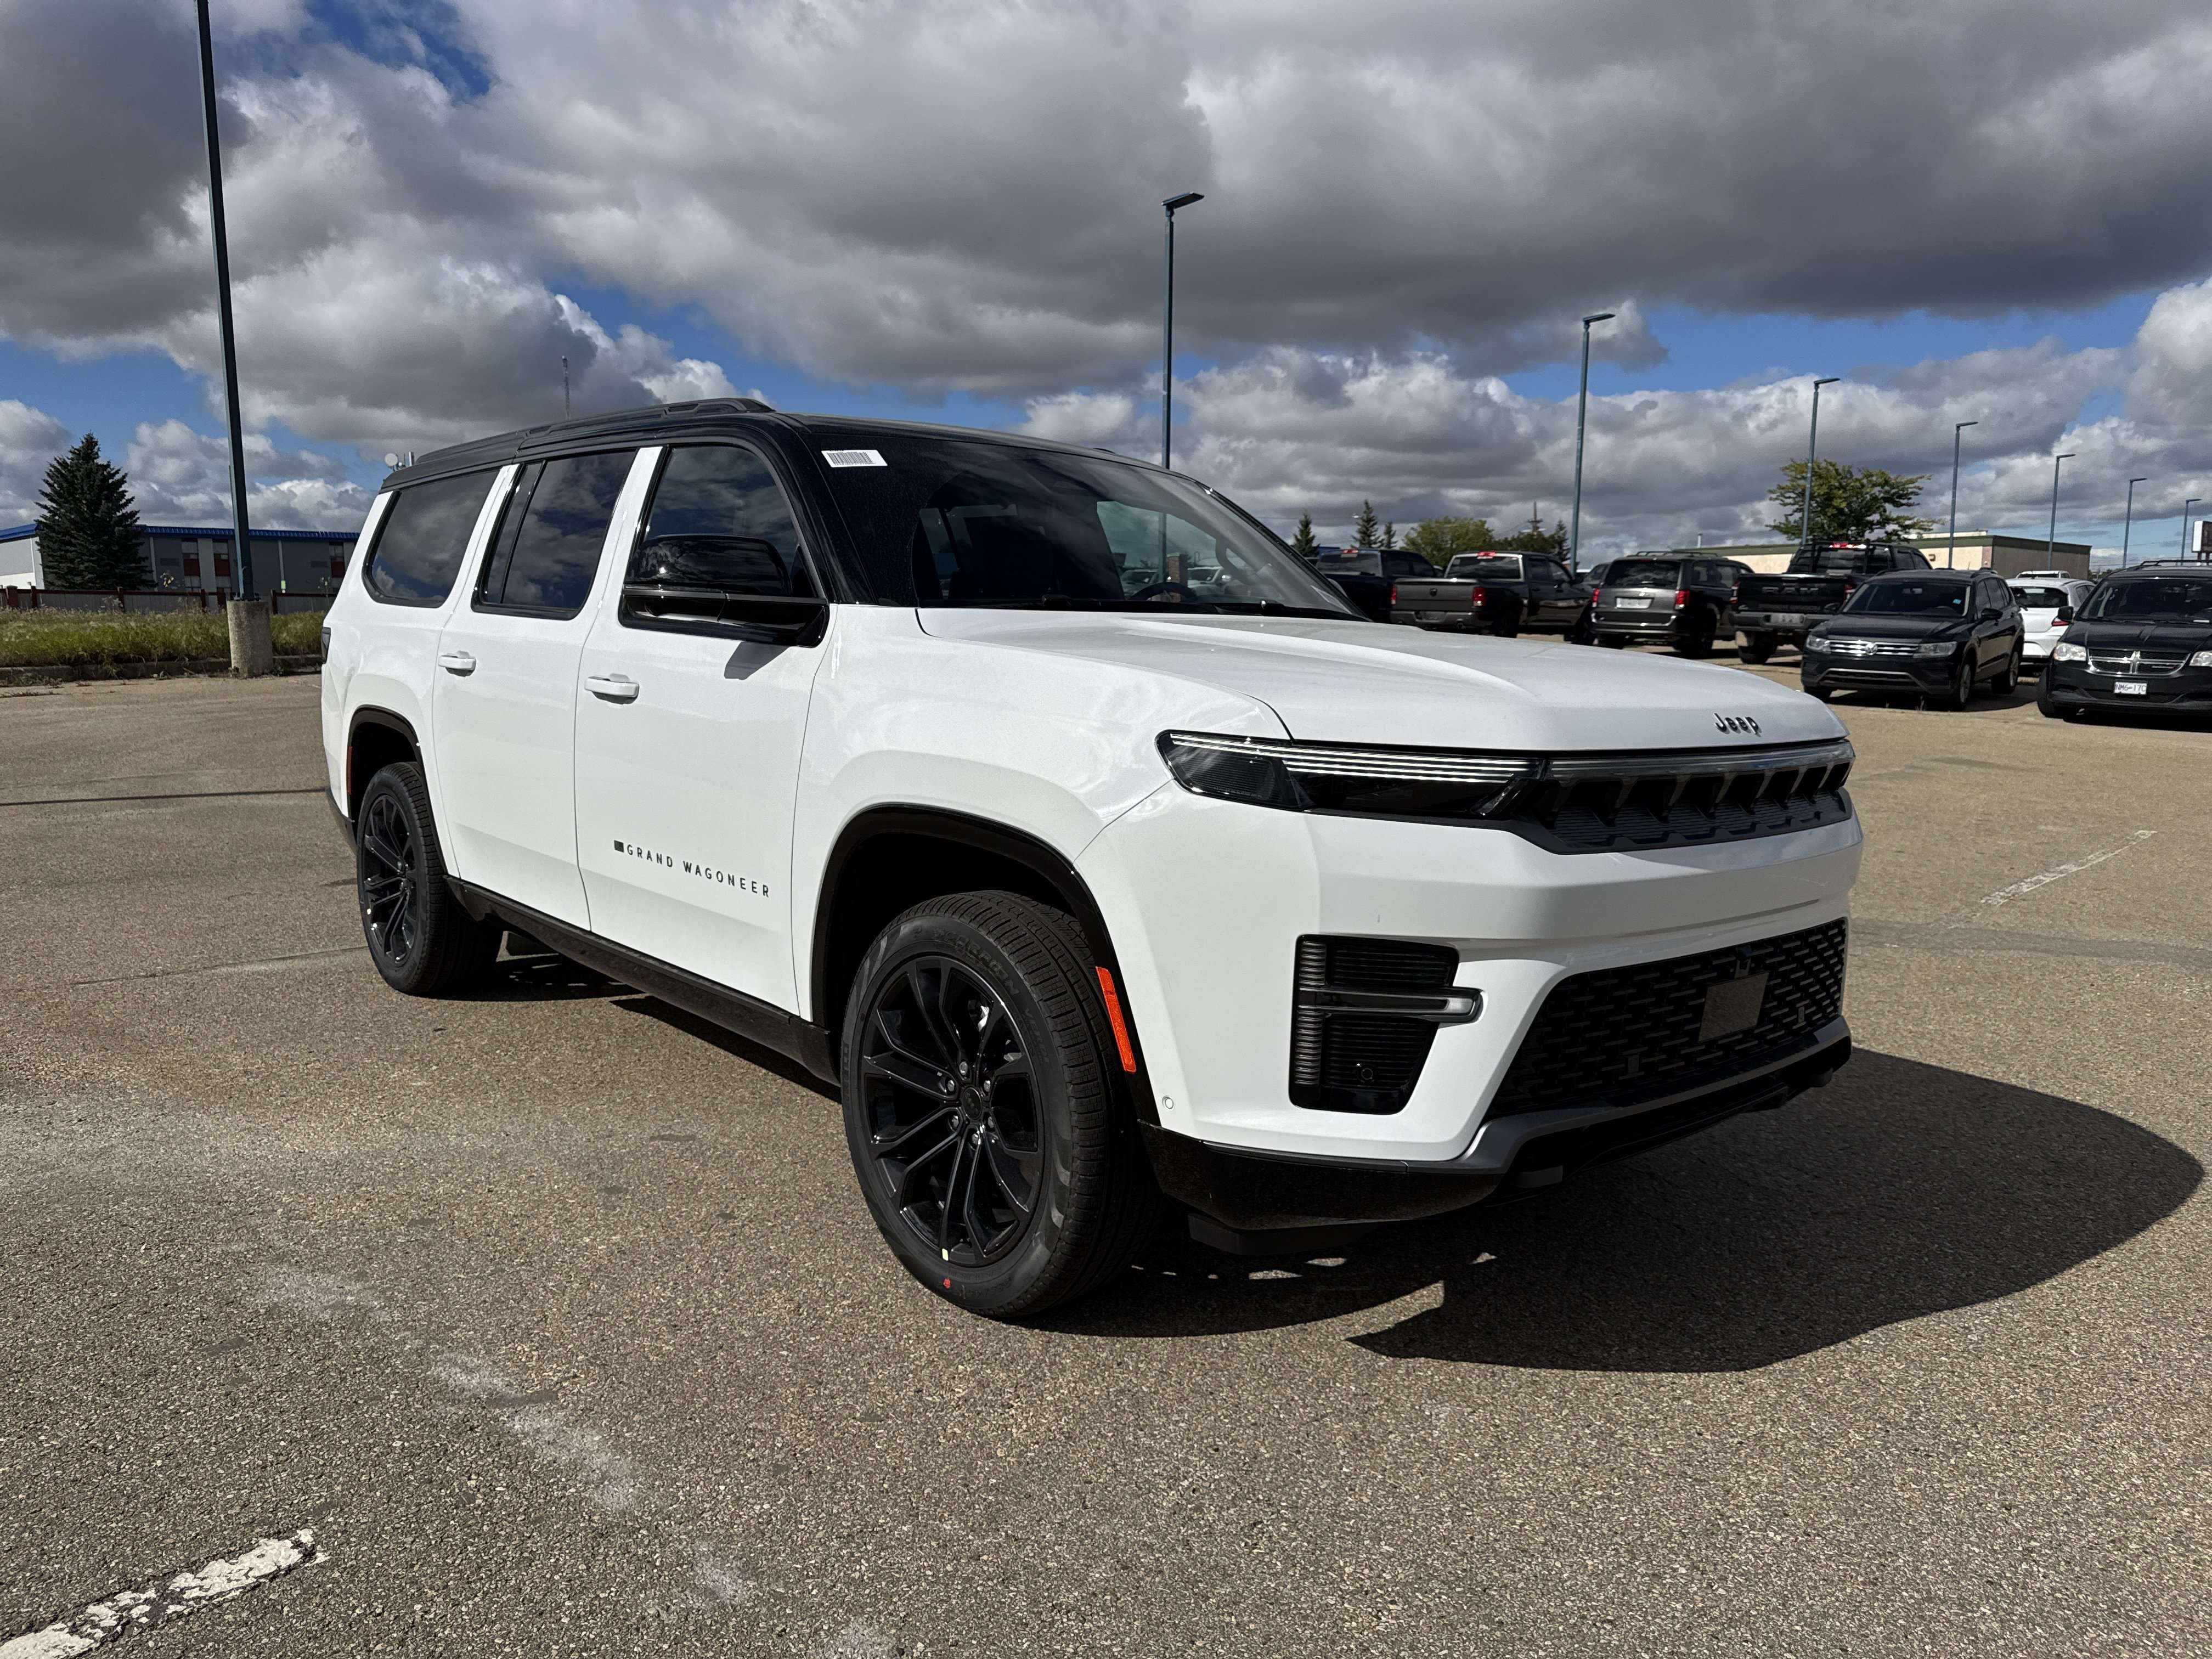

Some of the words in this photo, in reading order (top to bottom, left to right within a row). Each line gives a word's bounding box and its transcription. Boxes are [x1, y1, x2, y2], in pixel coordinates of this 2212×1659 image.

[1713, 713, 1759, 735] Jeep
[627, 844, 673, 867] GRAND
[683, 860, 769, 898] WAGONEER
